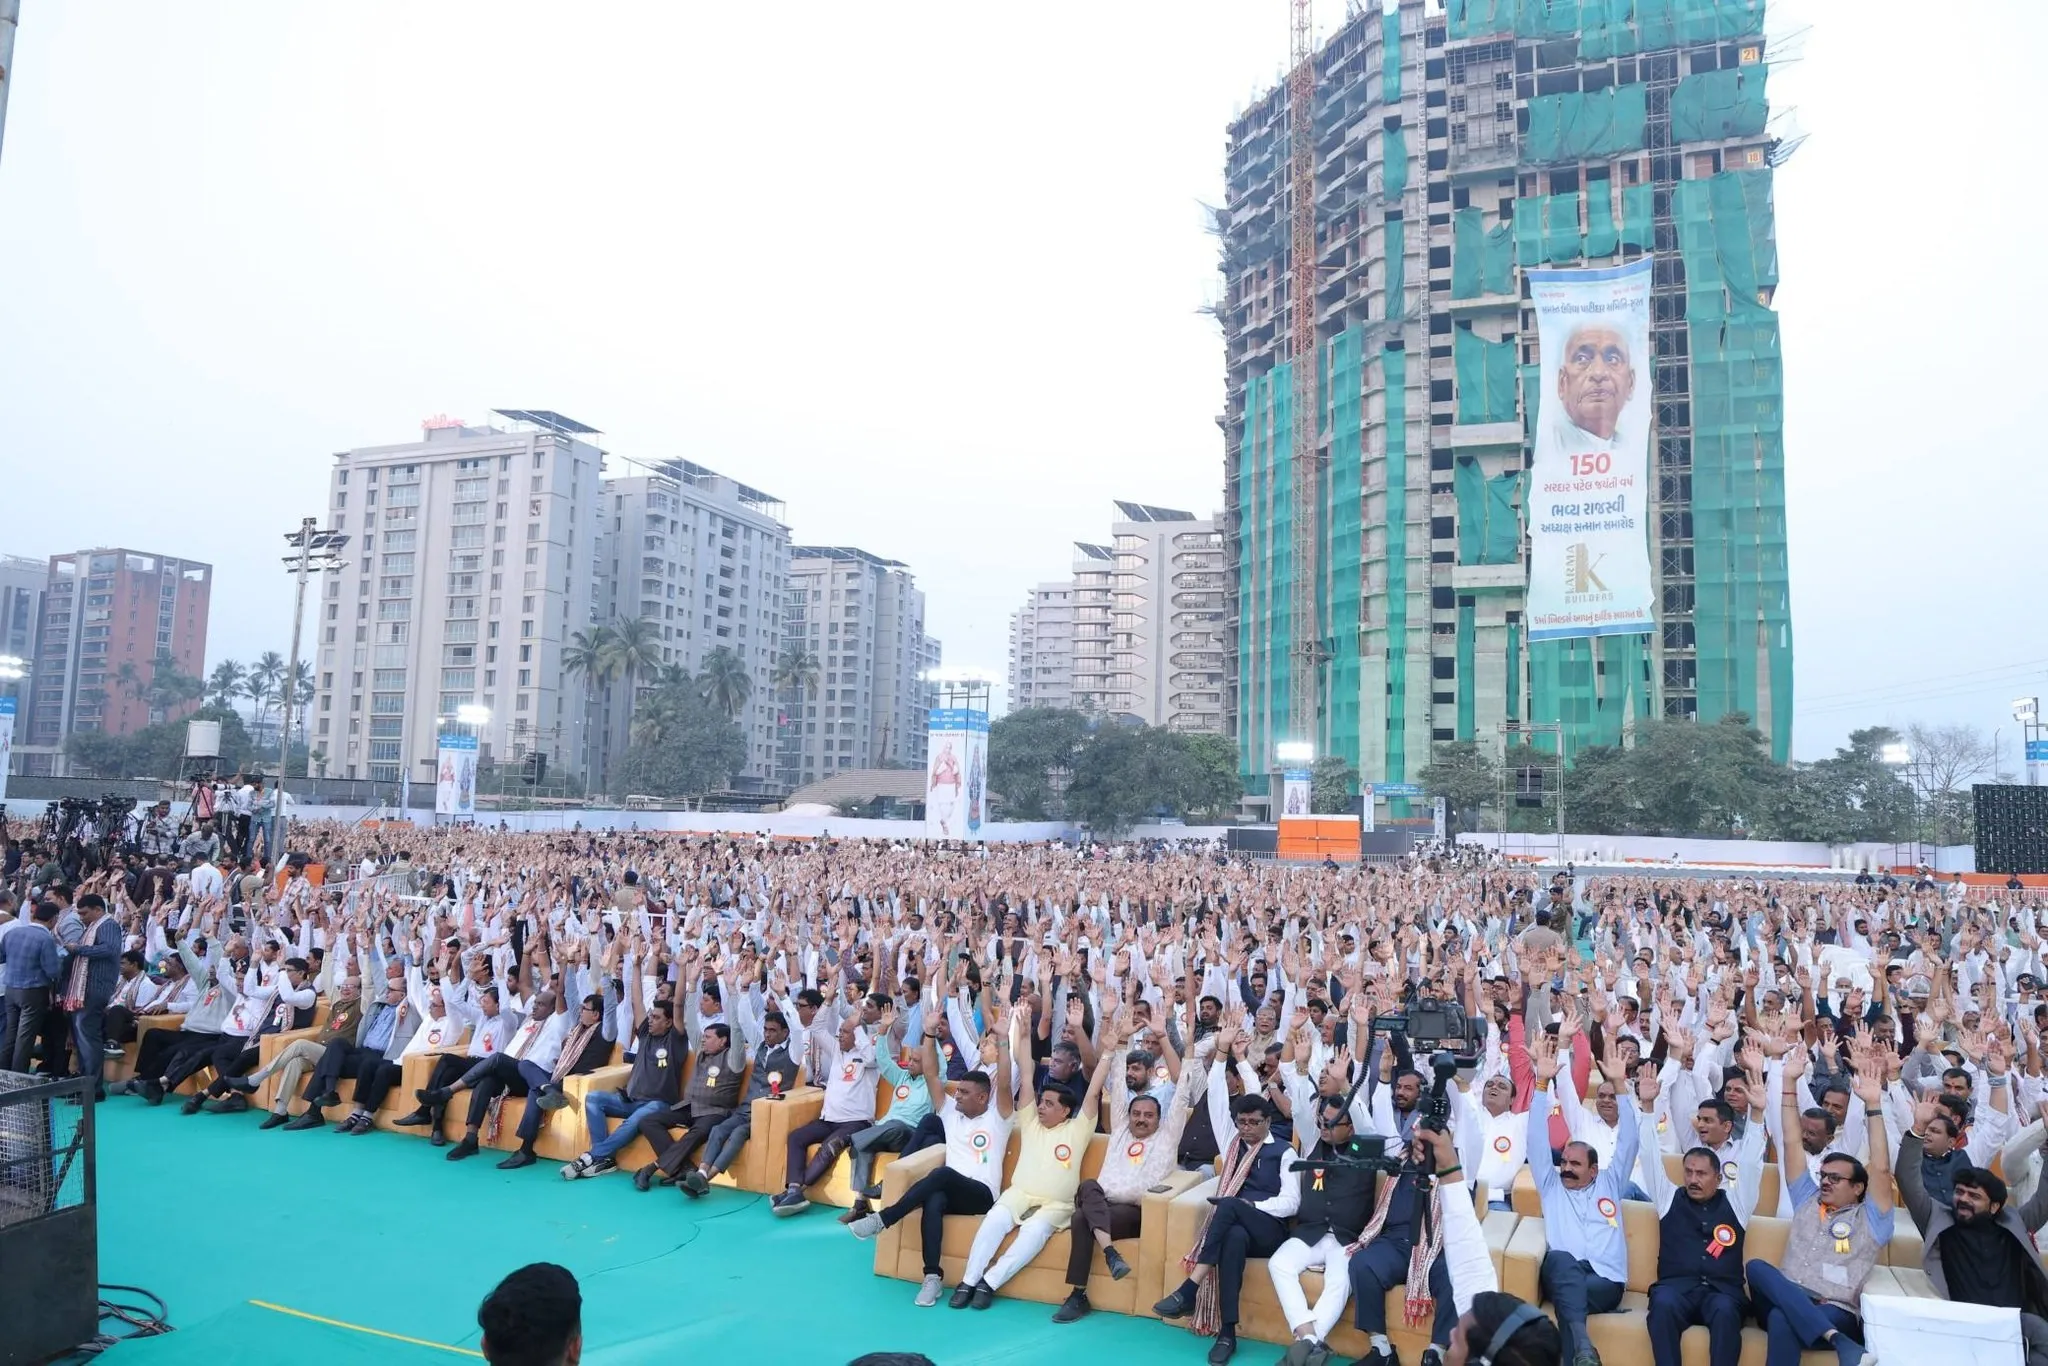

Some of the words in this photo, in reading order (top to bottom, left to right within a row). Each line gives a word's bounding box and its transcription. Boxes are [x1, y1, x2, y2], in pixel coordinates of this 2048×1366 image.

[1743, 49, 1756, 60] 21
[1569, 453, 1612, 476] 150
[1544, 482, 1571, 493] સરદાર
[1573, 478, 1593, 492] પટેલ
[1594, 476, 1618, 490] જયંતી
[1619, 474, 1634, 487] વર્ષ
[1551, 503, 1580, 517] ભવ્ય
[1583, 494, 1625, 516] રાજસ્વી
[1540, 522, 1572, 534] અધ્યક્ષ
[1573, 520, 1601, 533] સન્માન
[1603, 515, 1635, 531] સમારોહ
